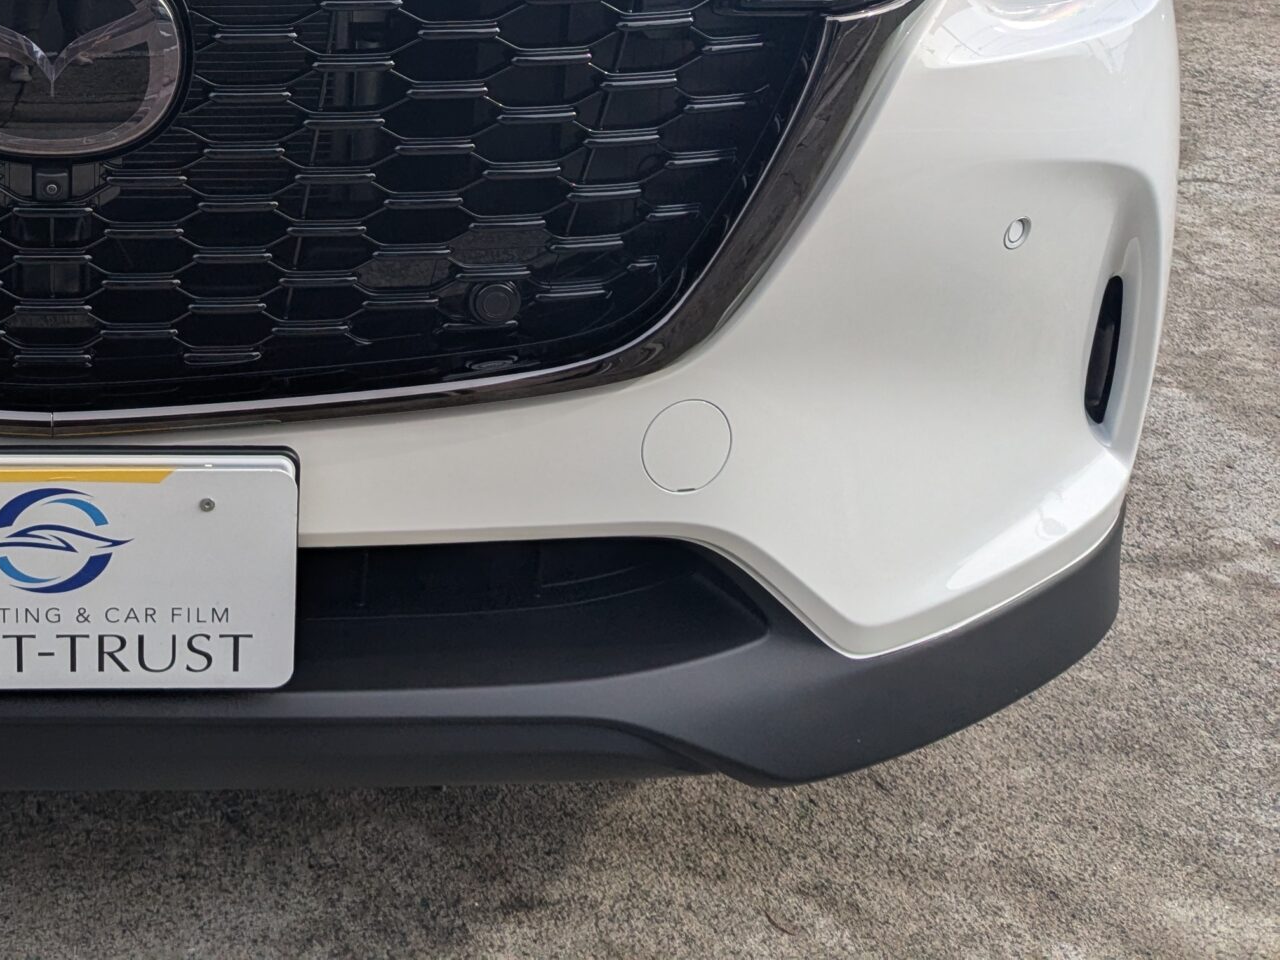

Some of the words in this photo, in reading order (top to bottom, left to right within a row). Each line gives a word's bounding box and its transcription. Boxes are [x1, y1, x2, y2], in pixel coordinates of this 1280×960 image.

[75, 607, 92, 624] &
[104, 607, 158, 624] CAR
[171, 607, 230, 623] FILM
